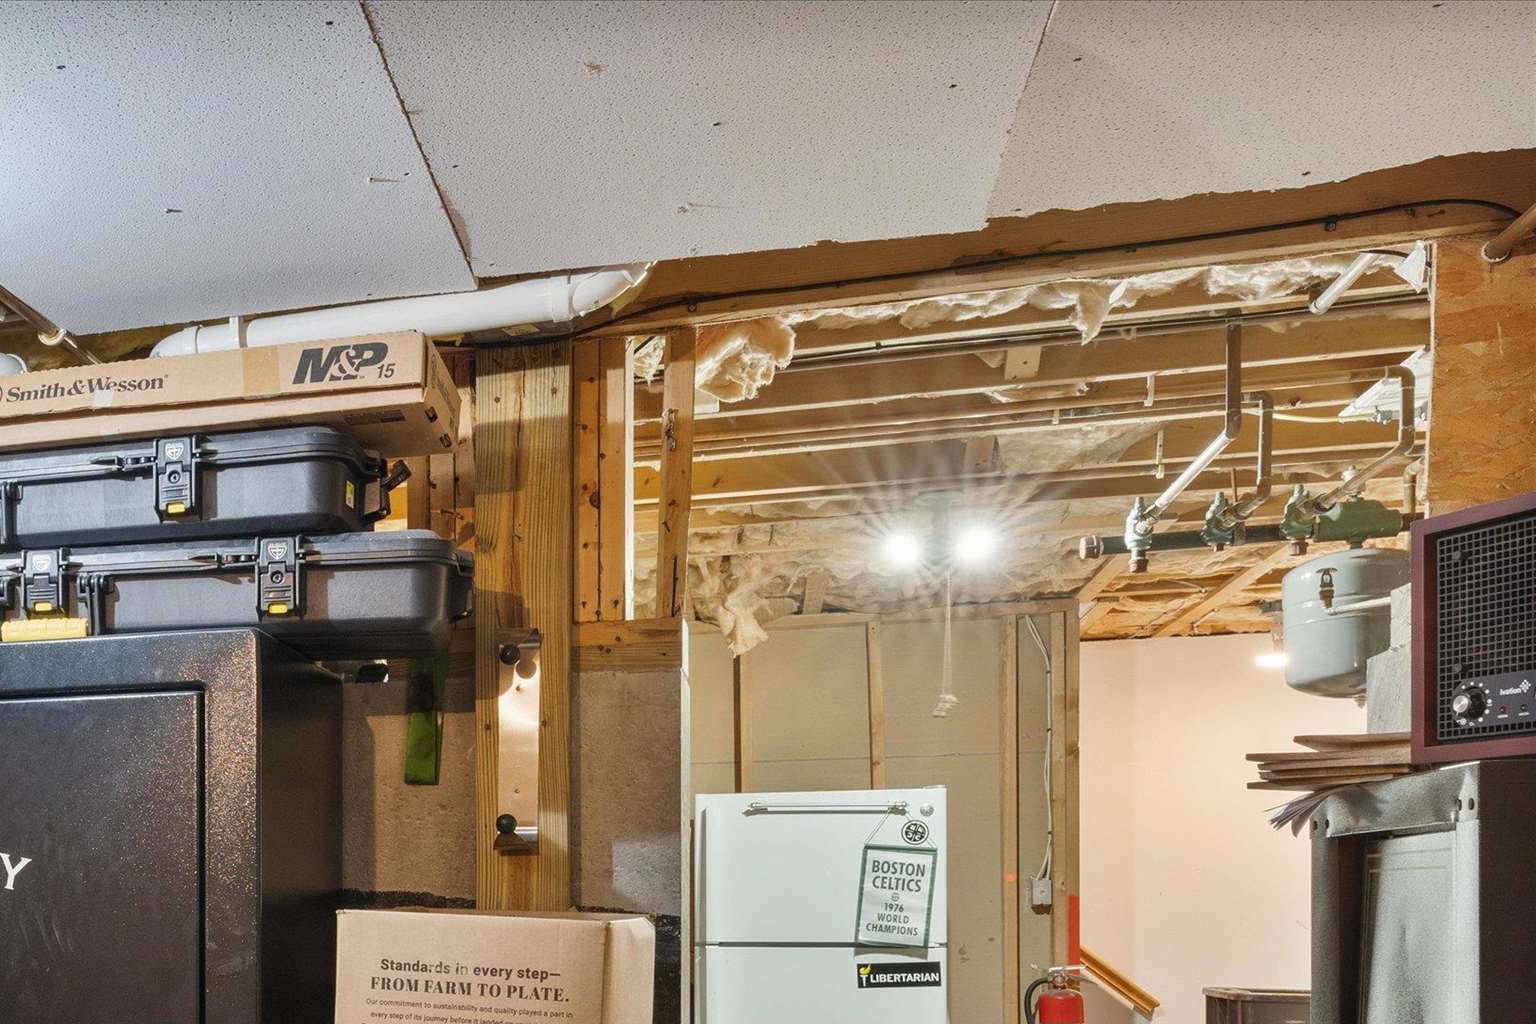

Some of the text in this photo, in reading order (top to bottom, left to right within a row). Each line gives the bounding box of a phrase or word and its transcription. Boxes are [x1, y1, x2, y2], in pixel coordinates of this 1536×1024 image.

[292, 341, 396, 384] M&P 15
[871, 859, 926, 877] BOSTON
[872, 875, 922, 893] CELTICS
[884, 902, 905, 913] 1976
[877, 912, 910, 924] WORLD
[865, 922, 919, 937] CHAMPIONS
[380, 958, 451, 975] Standards
[455, 962, 468, 975] in
[472, 965, 513, 981] every
[870, 972, 940, 983] LIBERTARIAN
[369, 976, 570, 1003] FROM FARM TO PLATE.
[365, 998, 378, 1006] Our
[379, 999, 423, 1009] commitment
[433, 1002, 478, 1013] sustainability
[479, 1005, 492, 1013] and
[493, 1006, 517, 1017] quality
[518, 1008, 542, 1018] played
[549, 1011, 565, 1019] part
[370, 1012, 388, 1021] every
[389, 1012, 404, 1021] step
[423, 1015, 449, 1024] journey
[450, 1016, 472, 1024] before
